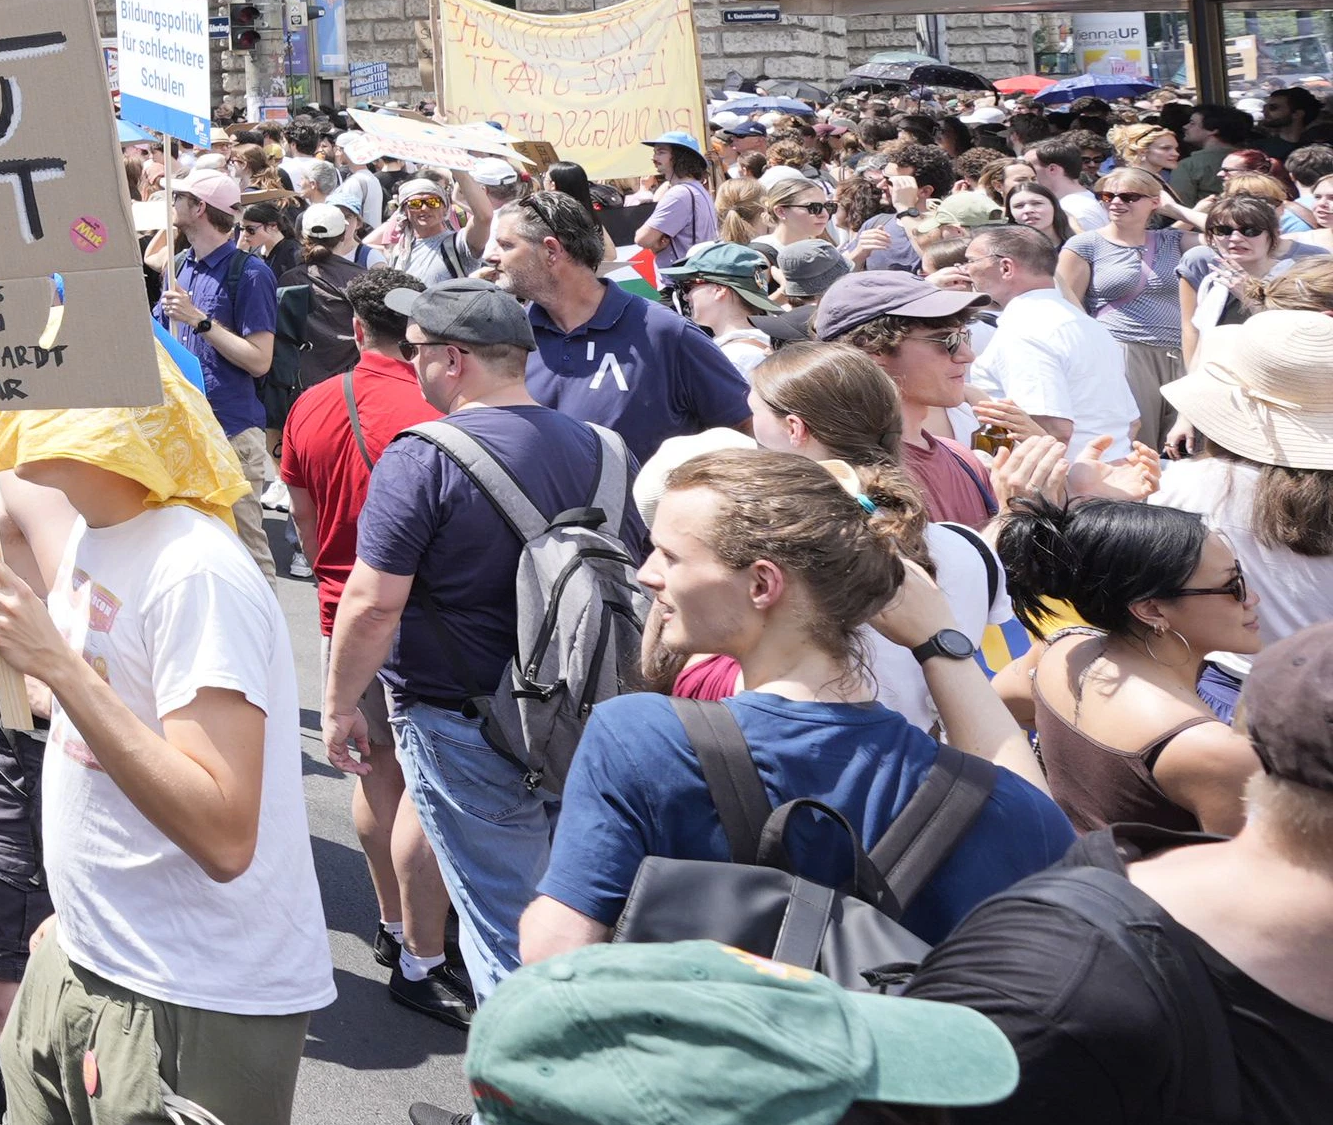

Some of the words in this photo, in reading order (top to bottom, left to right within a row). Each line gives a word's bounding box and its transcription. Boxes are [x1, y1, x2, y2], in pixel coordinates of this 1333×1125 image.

[121, 0, 203, 37] Bildungspolitik
[121, 30, 137, 51] für
[139, 38, 205, 70] schlechtere
[141, 67, 185, 97] Schulen
[74, 222, 103, 246] Mut
